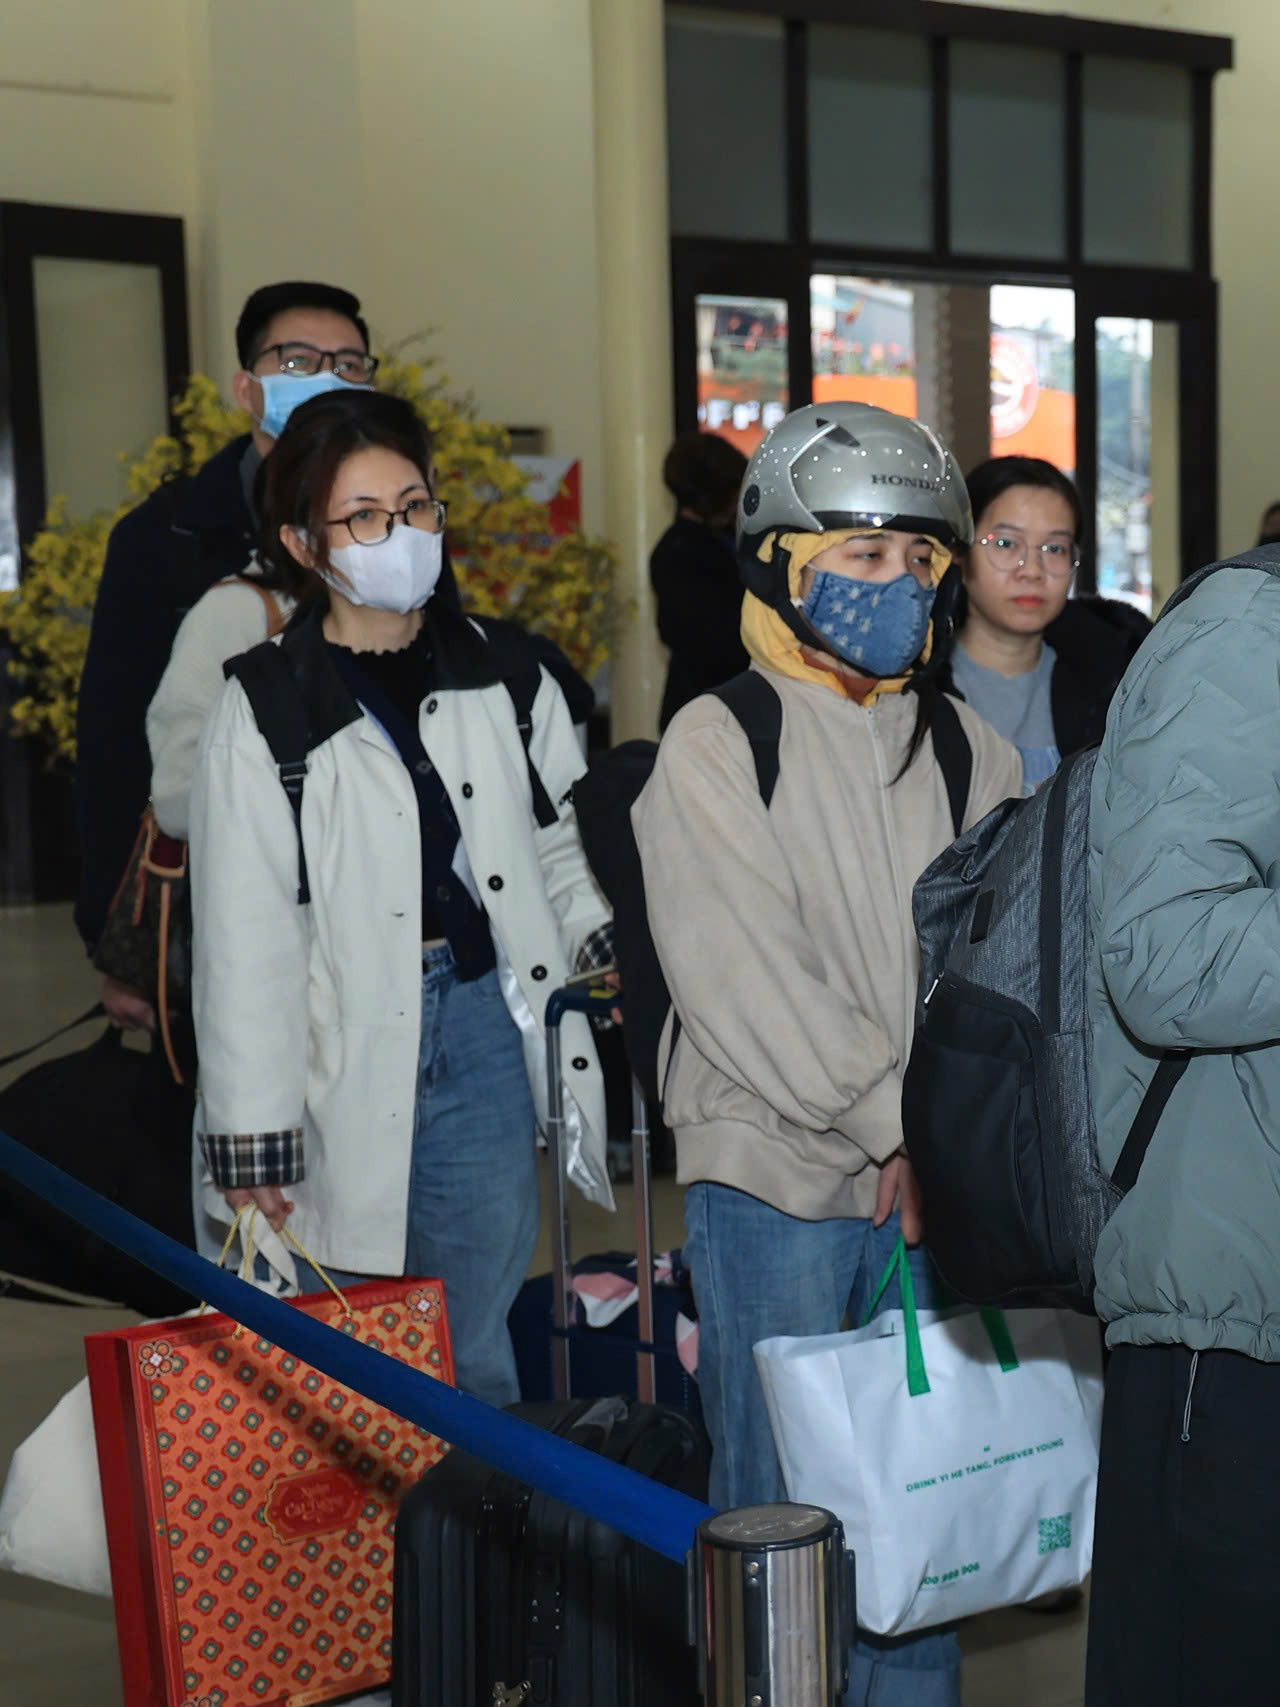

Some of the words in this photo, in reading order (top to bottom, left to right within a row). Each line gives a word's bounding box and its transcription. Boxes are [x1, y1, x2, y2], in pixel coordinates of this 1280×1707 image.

[871, 473, 941, 492] HONDA
[906, 1477, 937, 1492] DRINK
[951, 1469, 964, 1479] HE
[993, 1448, 1034, 1465] FOREVER
[1036, 1437, 1065, 1454] YOUNG
